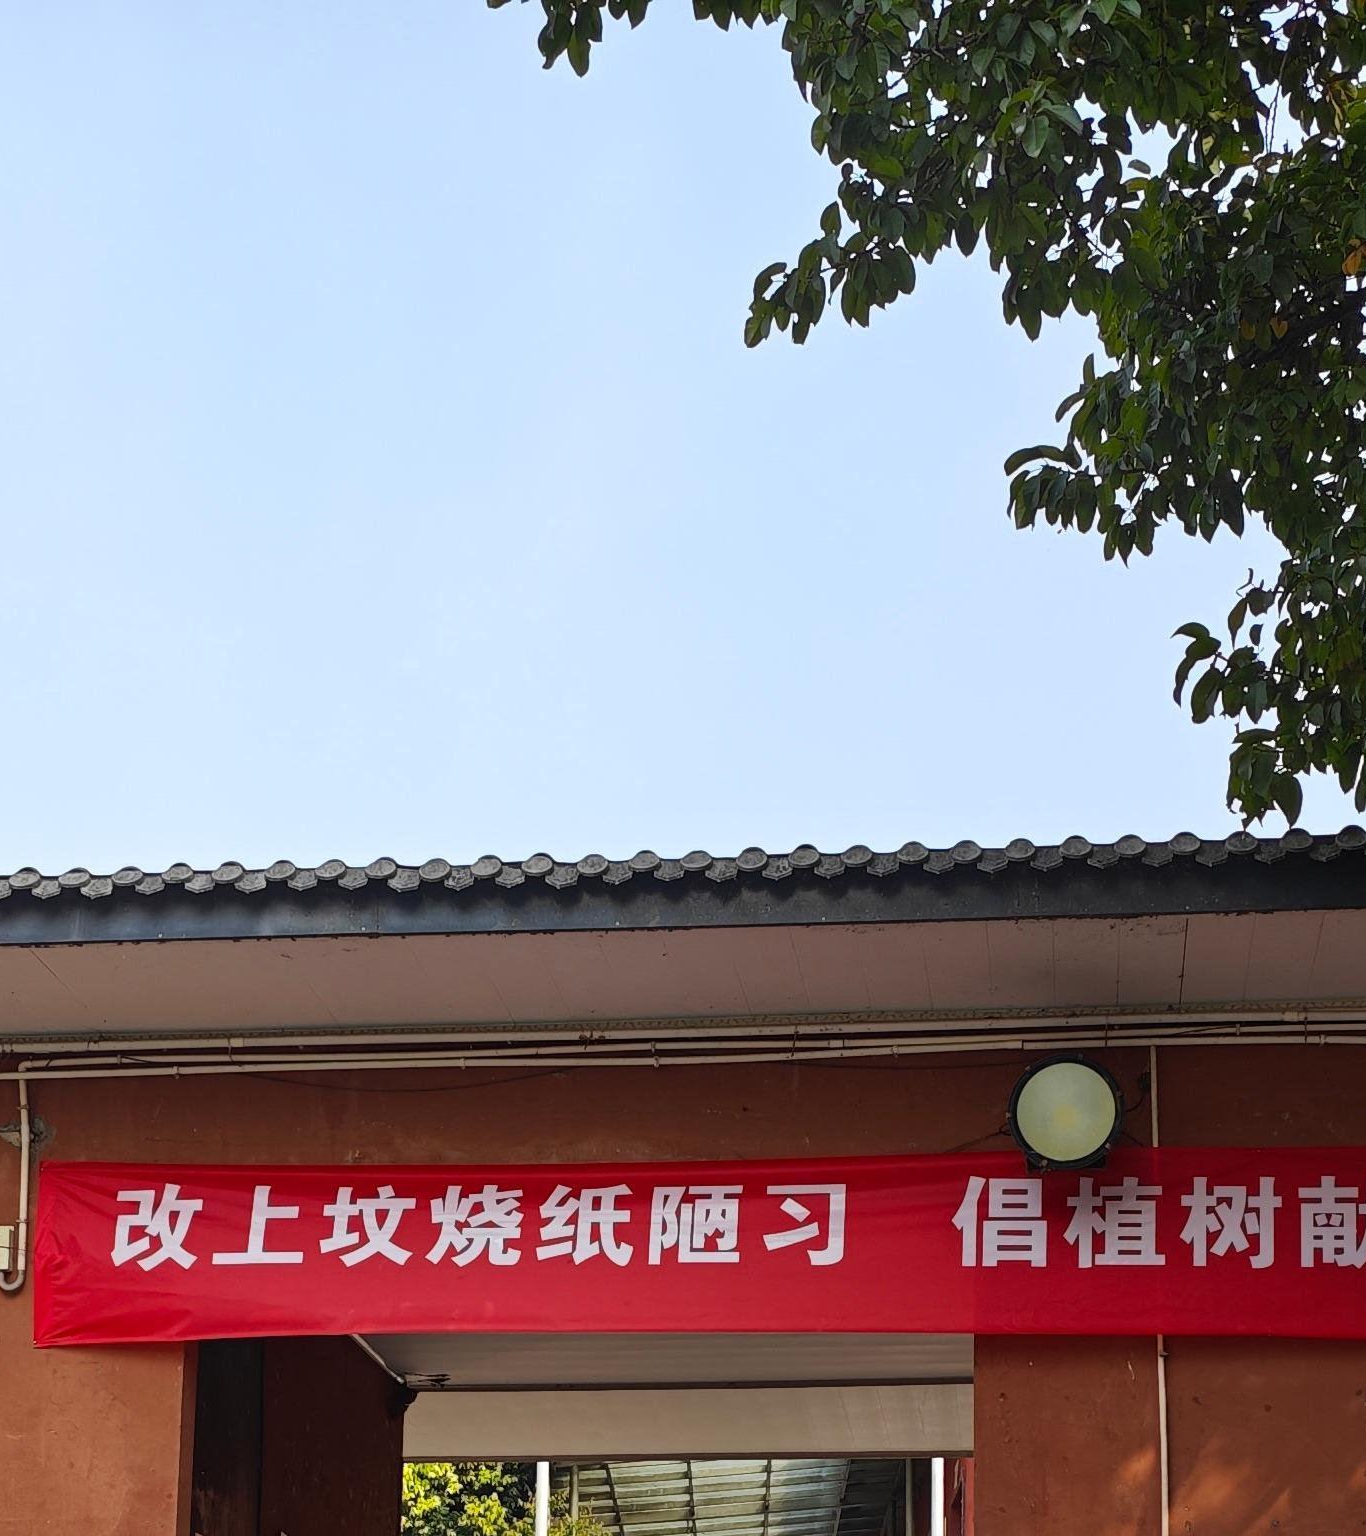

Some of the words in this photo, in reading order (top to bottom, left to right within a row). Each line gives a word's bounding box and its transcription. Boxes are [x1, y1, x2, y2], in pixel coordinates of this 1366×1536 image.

[110, 1182, 848, 1270] 改上坟烧纸陋习
